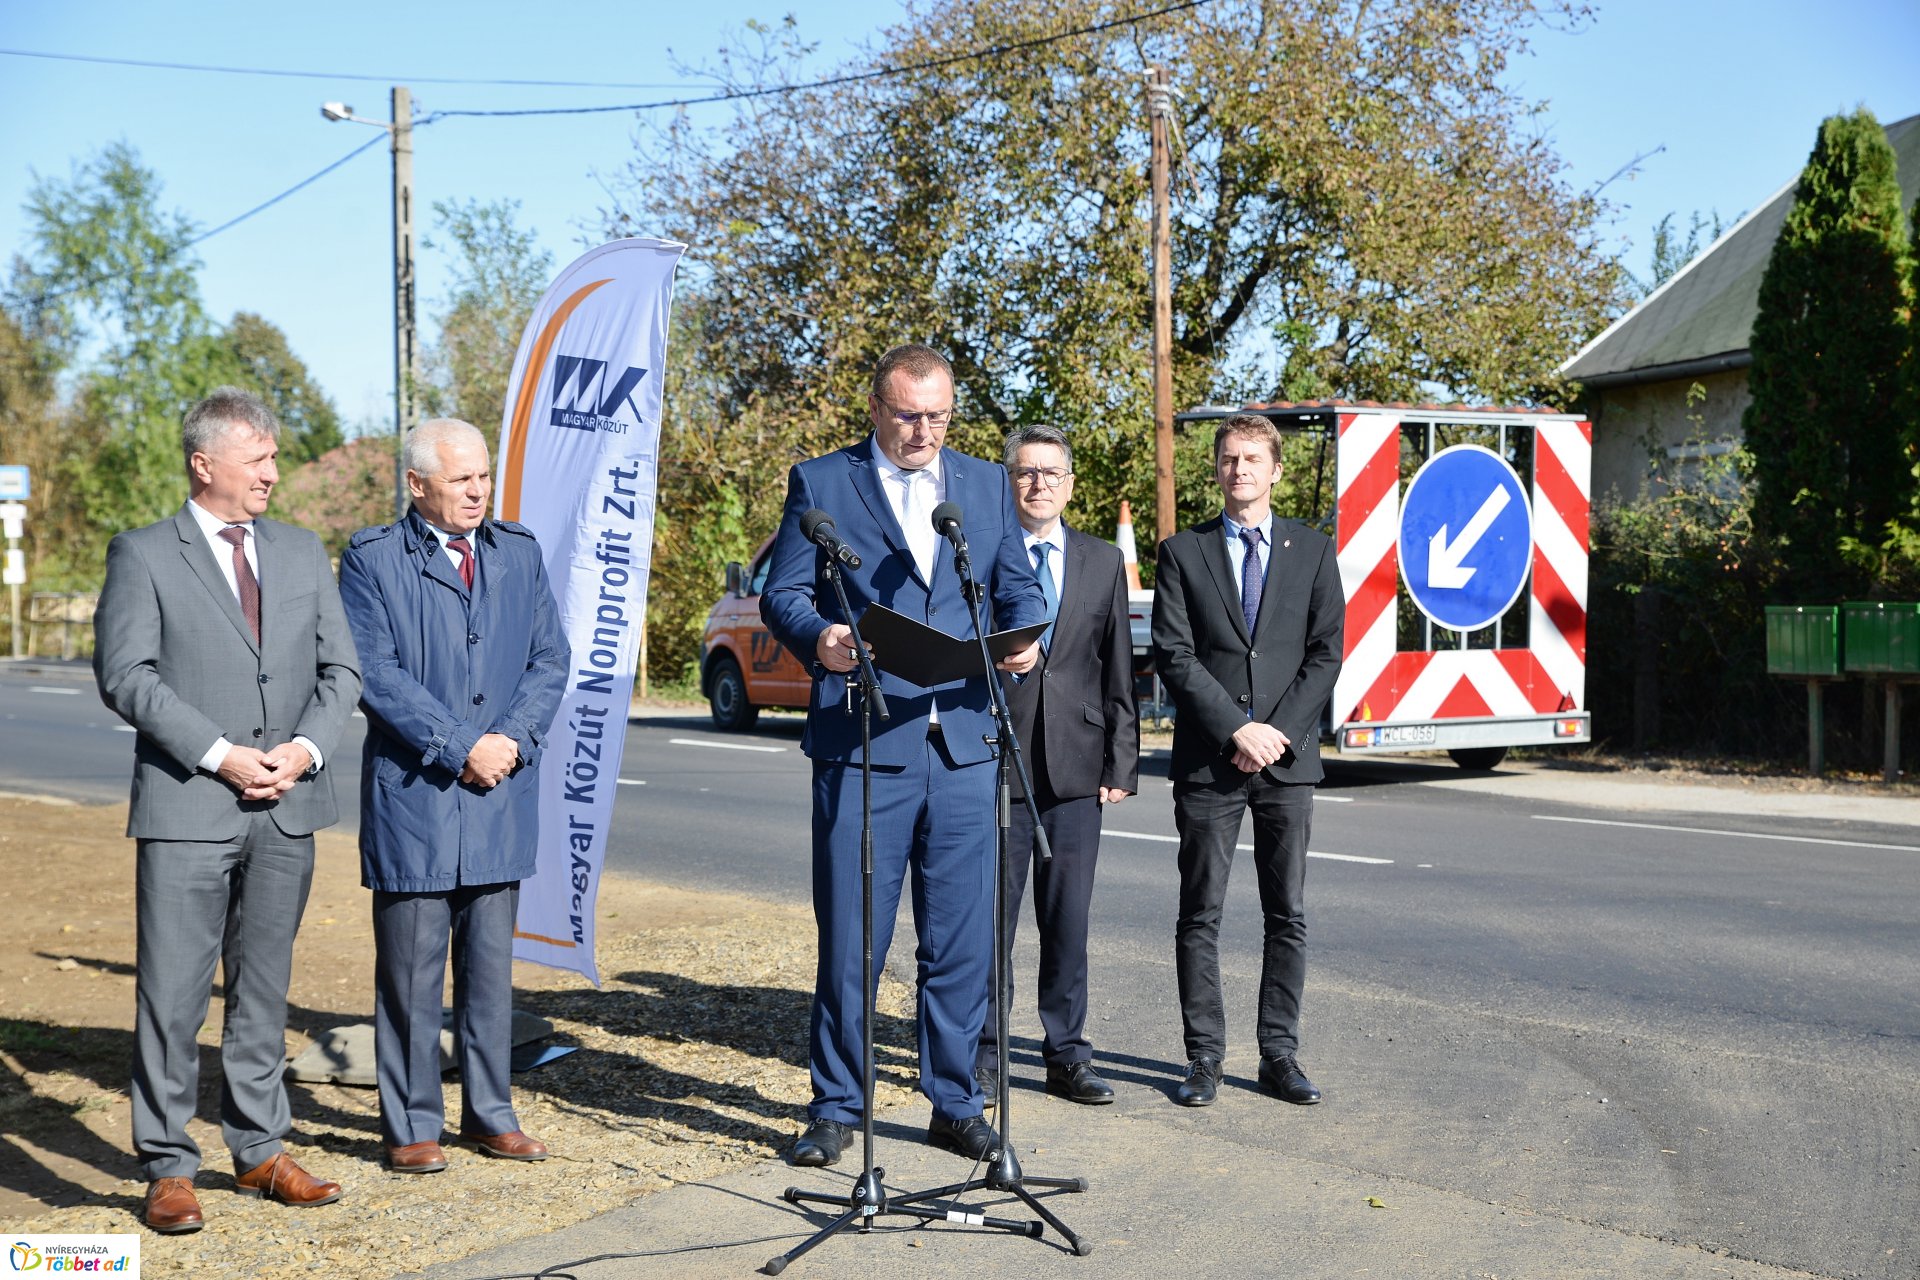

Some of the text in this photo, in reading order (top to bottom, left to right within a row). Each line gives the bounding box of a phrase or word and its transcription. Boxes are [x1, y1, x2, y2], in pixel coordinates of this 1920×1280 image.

[561, 413, 629, 435] MAGYAR KÖZÚT
[602, 460, 639, 520] Zrt.
[576, 529, 633, 695] Nonprofit
[564, 704, 609, 805] Közút
